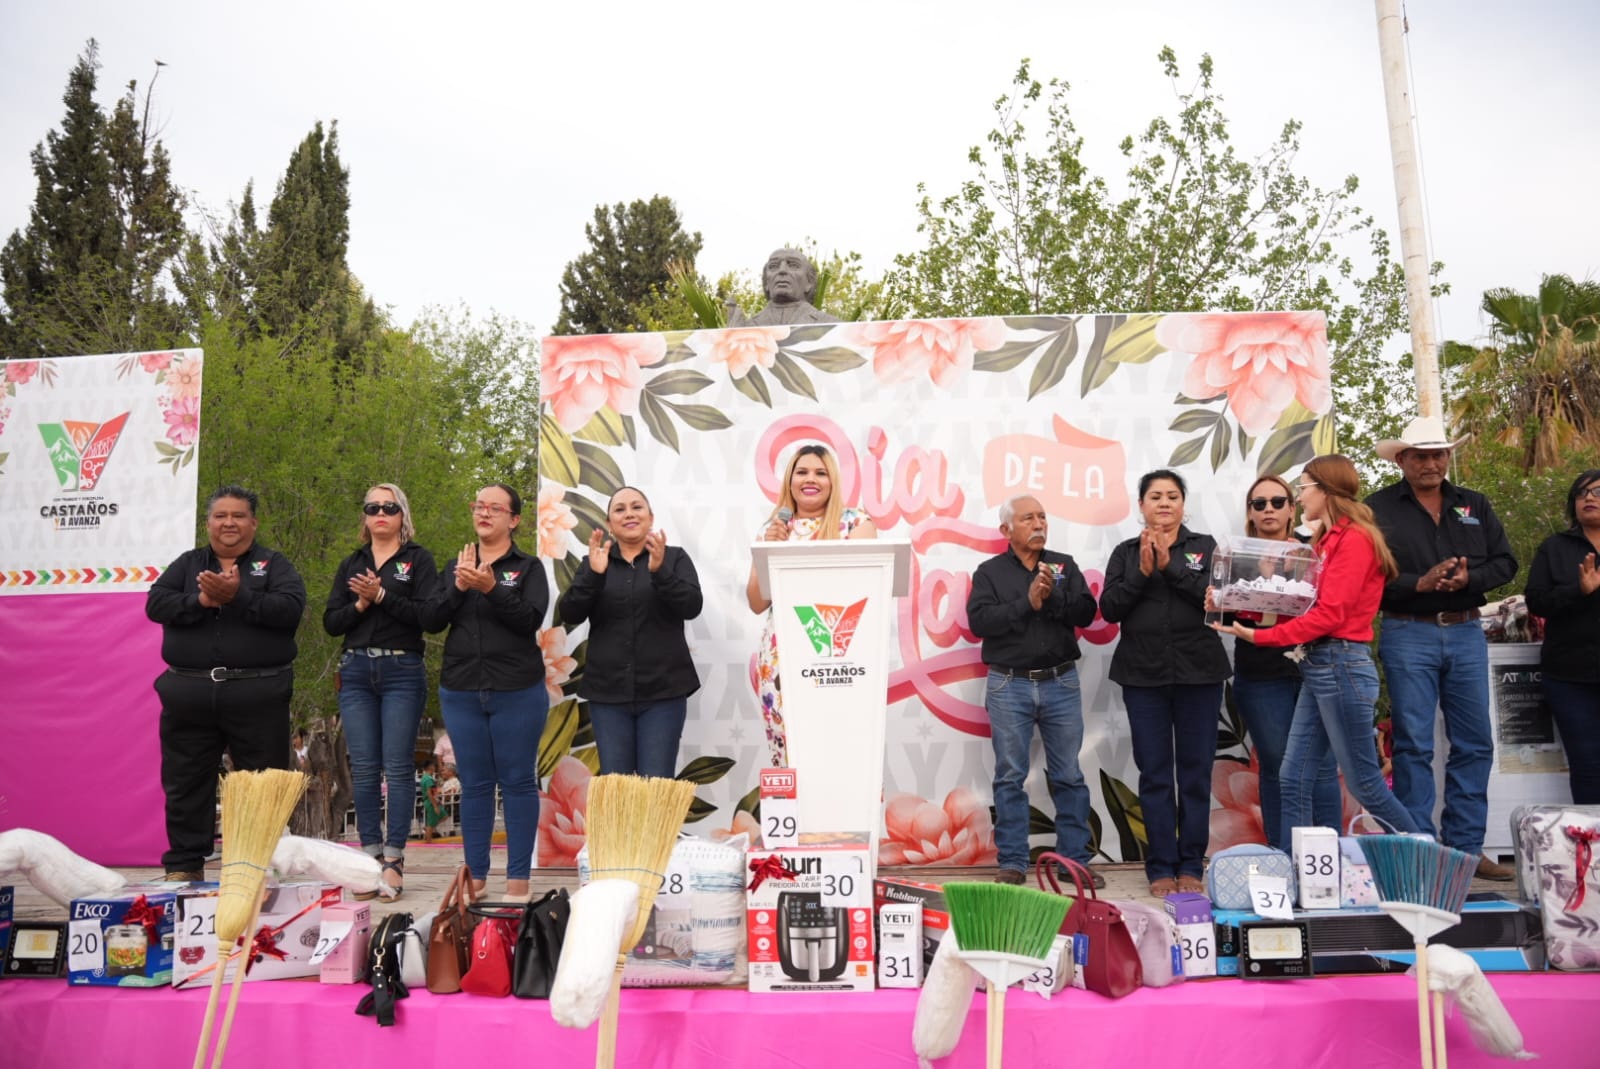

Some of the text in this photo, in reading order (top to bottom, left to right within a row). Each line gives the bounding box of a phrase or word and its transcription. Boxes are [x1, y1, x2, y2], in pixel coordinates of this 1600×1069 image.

[1003, 452, 1105, 500] DE LA
[40, 501, 118, 518] CASTAÑOS
[69, 516, 100, 526] AVANZA
[801, 665, 866, 677] CASTAÑOS
[826, 677, 853, 685] AVANZA
[764, 776, 792, 786] YETI
[767, 816, 797, 838] 29
[1304, 854, 1334, 876] 38
[823, 874, 854, 897] 30
[74, 902, 112, 918] EKCO
[1257, 891, 1287, 909] 37
[190, 914, 216, 936] 21
[884, 913, 912, 924] YETI
[72, 932, 98, 956] 20
[1182, 938, 1209, 960] 36
[885, 956, 915, 978] 31
